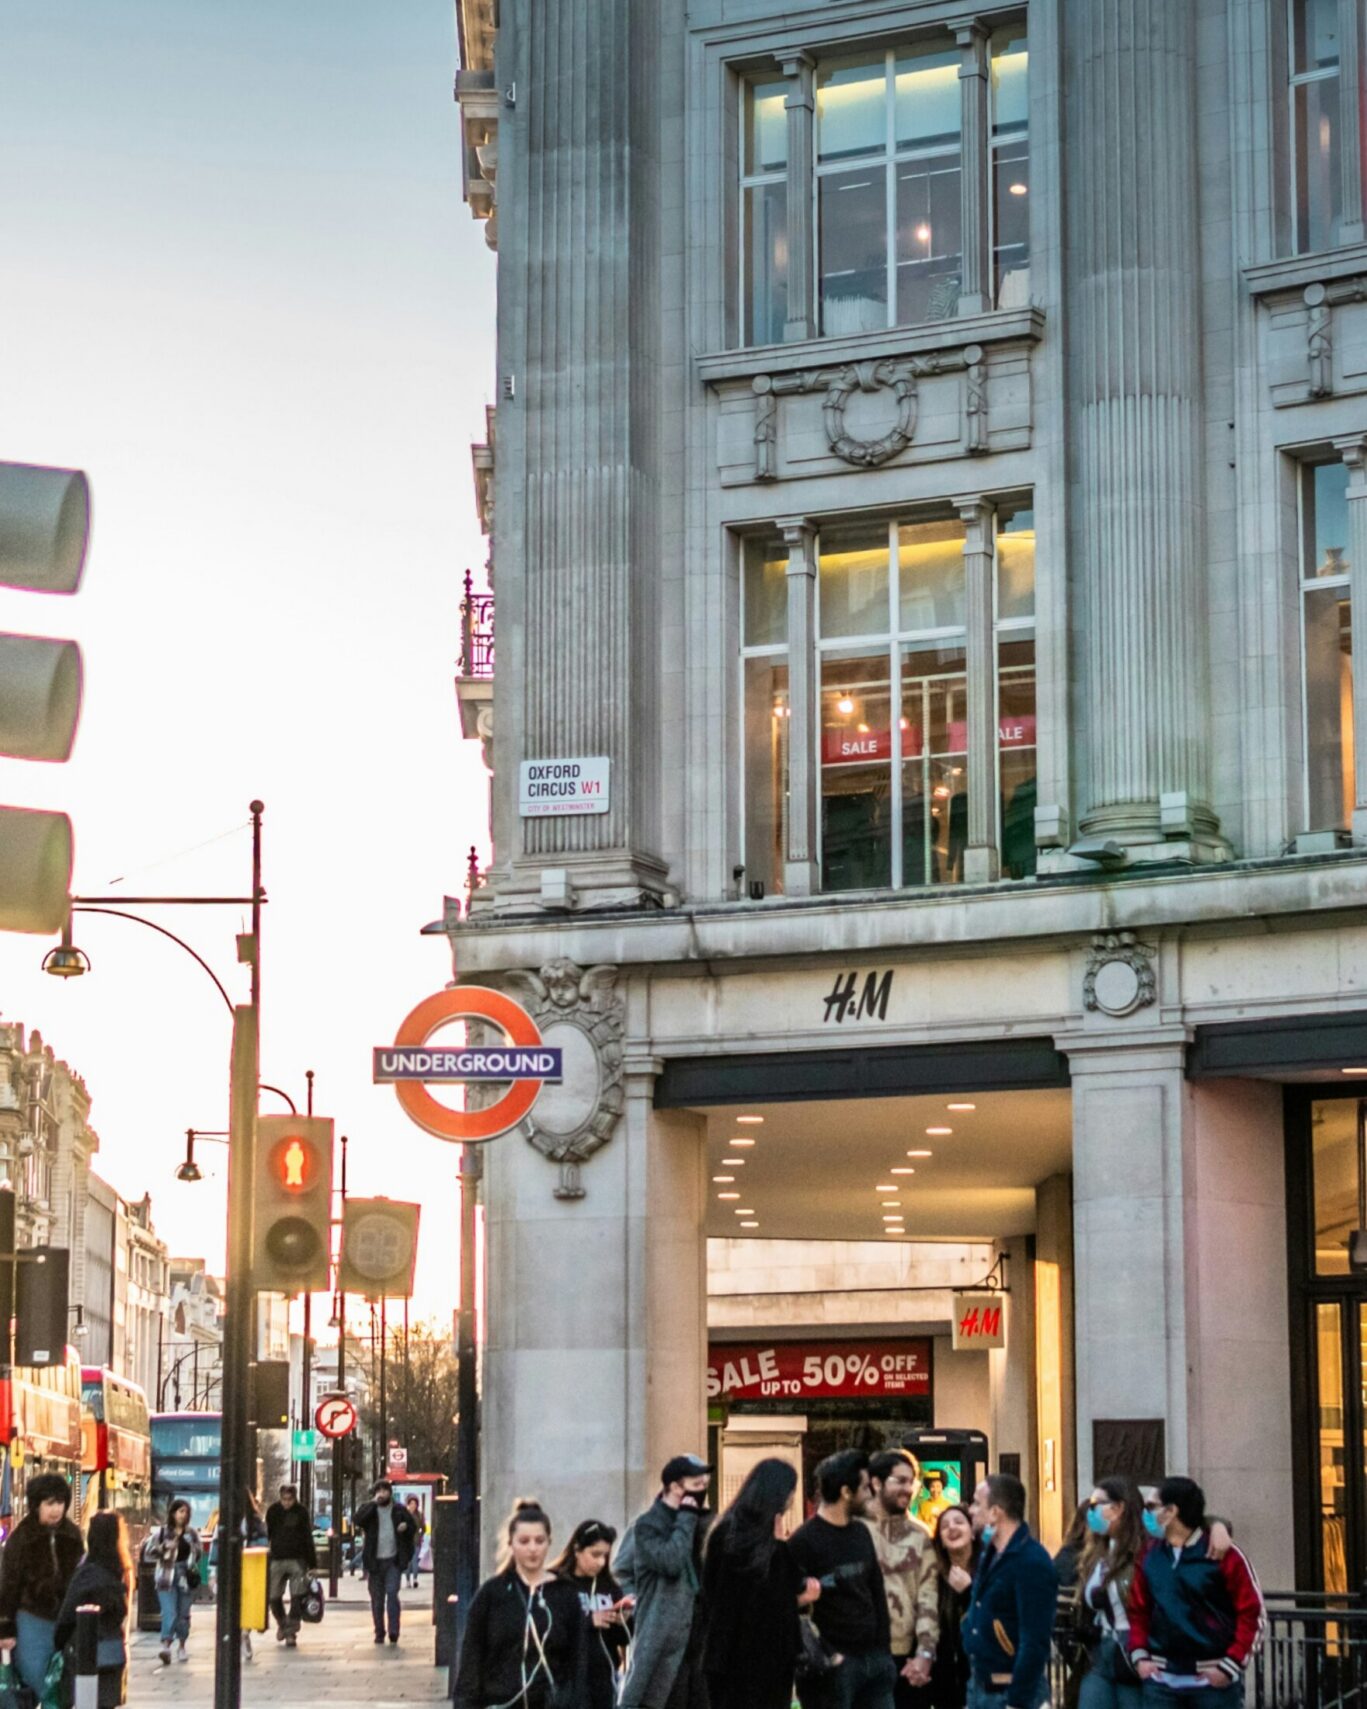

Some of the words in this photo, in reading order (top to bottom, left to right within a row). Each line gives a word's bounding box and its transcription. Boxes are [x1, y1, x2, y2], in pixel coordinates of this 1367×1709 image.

[998, 726, 1023, 741] ALE
[841, 741, 877, 755] SALE
[528, 764, 581, 780] OXFORD
[528, 781, 576, 797] CIRCUS
[581, 780, 601, 794] W1
[823, 969, 894, 1023] H&M
[381, 1053, 555, 1072] UNDERGROUND
[959, 1306, 1001, 1338] H&M
[706, 1349, 780, 1397] SALE
[761, 1380, 780, 1395] UP
[781, 1379, 801, 1394] TO
[802, 1354, 880, 1387] 50%
[881, 1354, 917, 1371] OFF
